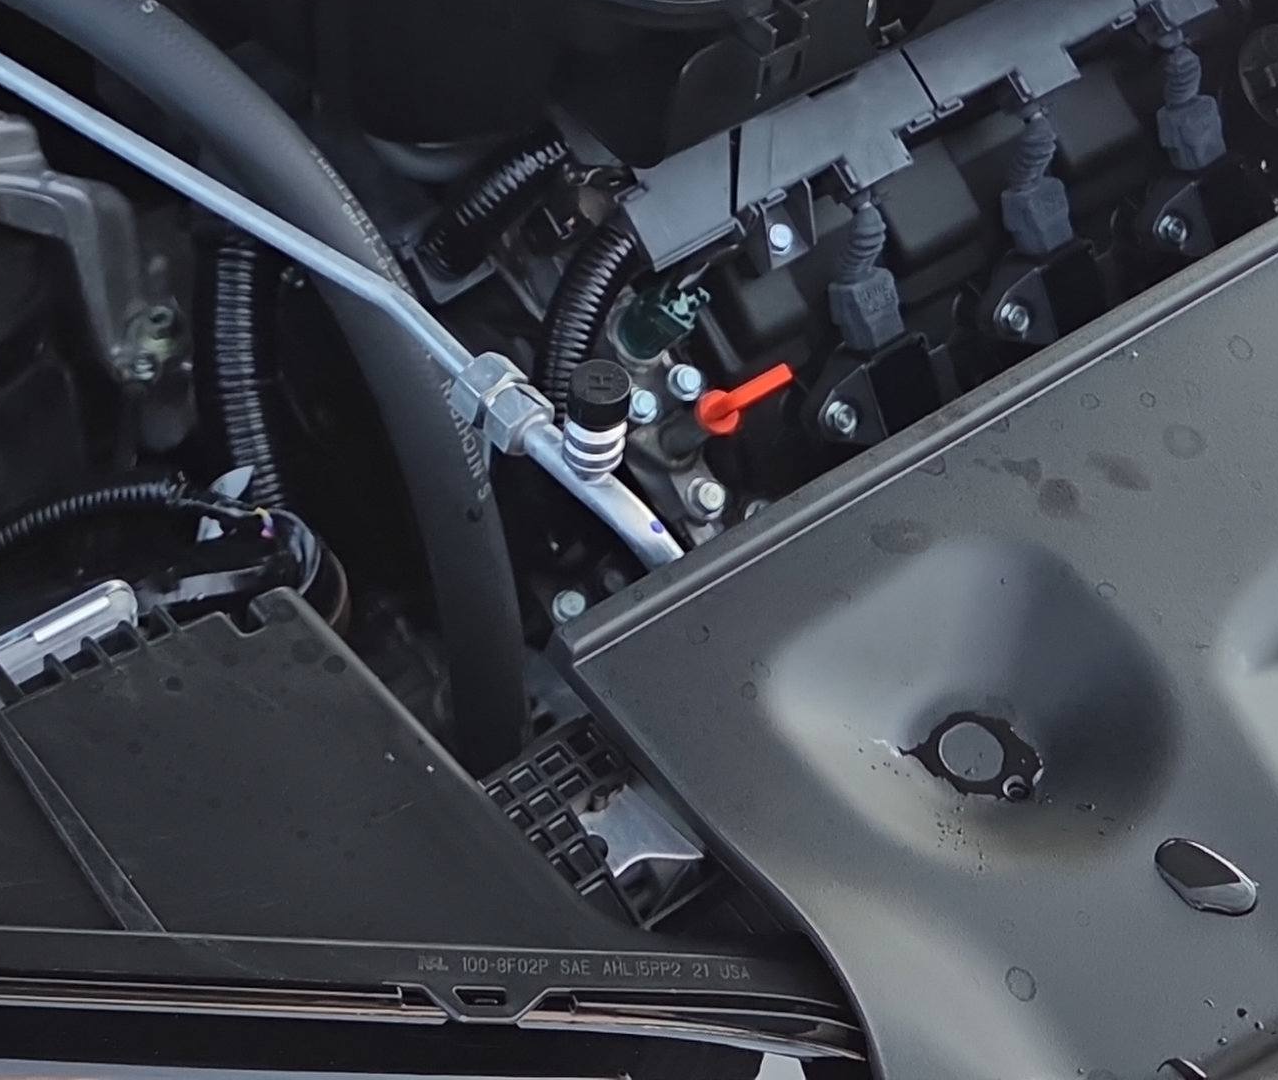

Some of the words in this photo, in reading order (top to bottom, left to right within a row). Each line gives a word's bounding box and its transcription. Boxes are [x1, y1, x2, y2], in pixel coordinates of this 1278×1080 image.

[462, 956, 549, 974] 100-8F02P
[560, 959, 591, 976] SAE
[692, 962, 710, 978] 21
[720, 963, 751, 980] USA
